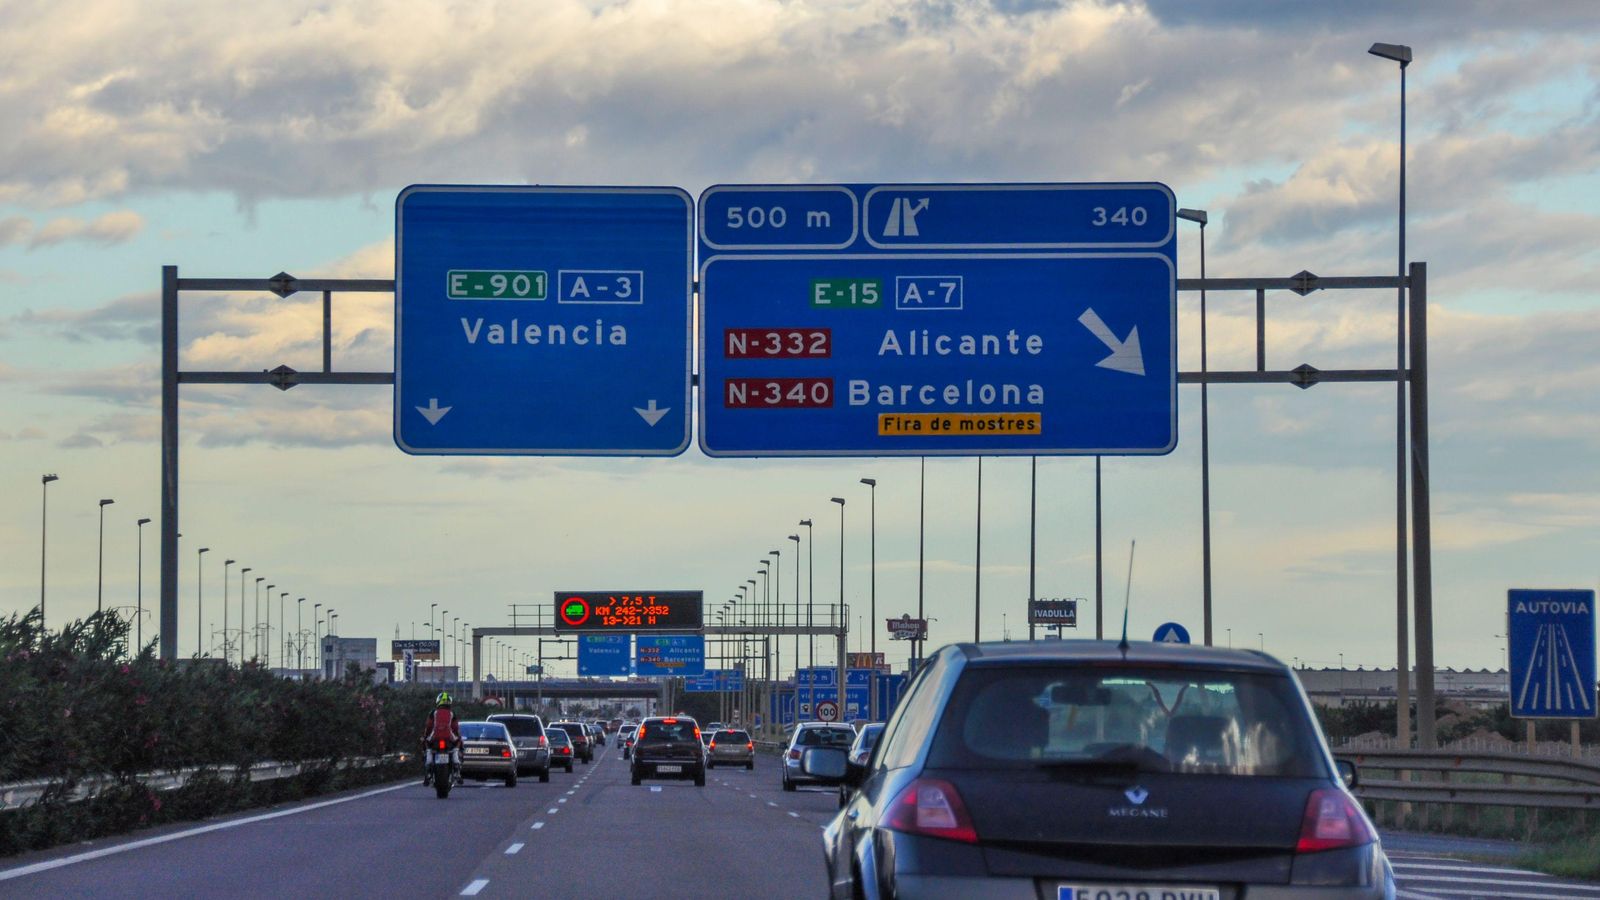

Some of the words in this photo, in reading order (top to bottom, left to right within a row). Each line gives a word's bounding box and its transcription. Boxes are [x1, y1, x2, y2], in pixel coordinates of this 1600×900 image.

[727, 206, 787, 229] 500
[807, 210, 831, 228] m
[1092, 207, 1148, 227] 340
[451, 274, 545, 297] E-901
[570, 276, 632, 298] A-3
[814, 283, 878, 305] E-15
[902, 282, 957, 304] A-7
[460, 318, 628, 345] Valencia
[728, 332, 828, 355] N-332
[878, 329, 1044, 356] Alicante
[728, 382, 830, 405] N-340
[849, 379, 1045, 406] Barcelona
[884, 416, 924, 432] Fira
[930, 417, 952, 432] de
[959, 418, 1036, 432] mostres
[648, 596, 656, 605] T
[1515, 601, 1589, 614] AUTOVIA
[595, 606, 611, 615] KM
[648, 616, 657, 625] H
[892, 621, 920, 630] Mahou
[819, 708, 836, 717] 100
[1109, 808, 1168, 817] MEGANE
